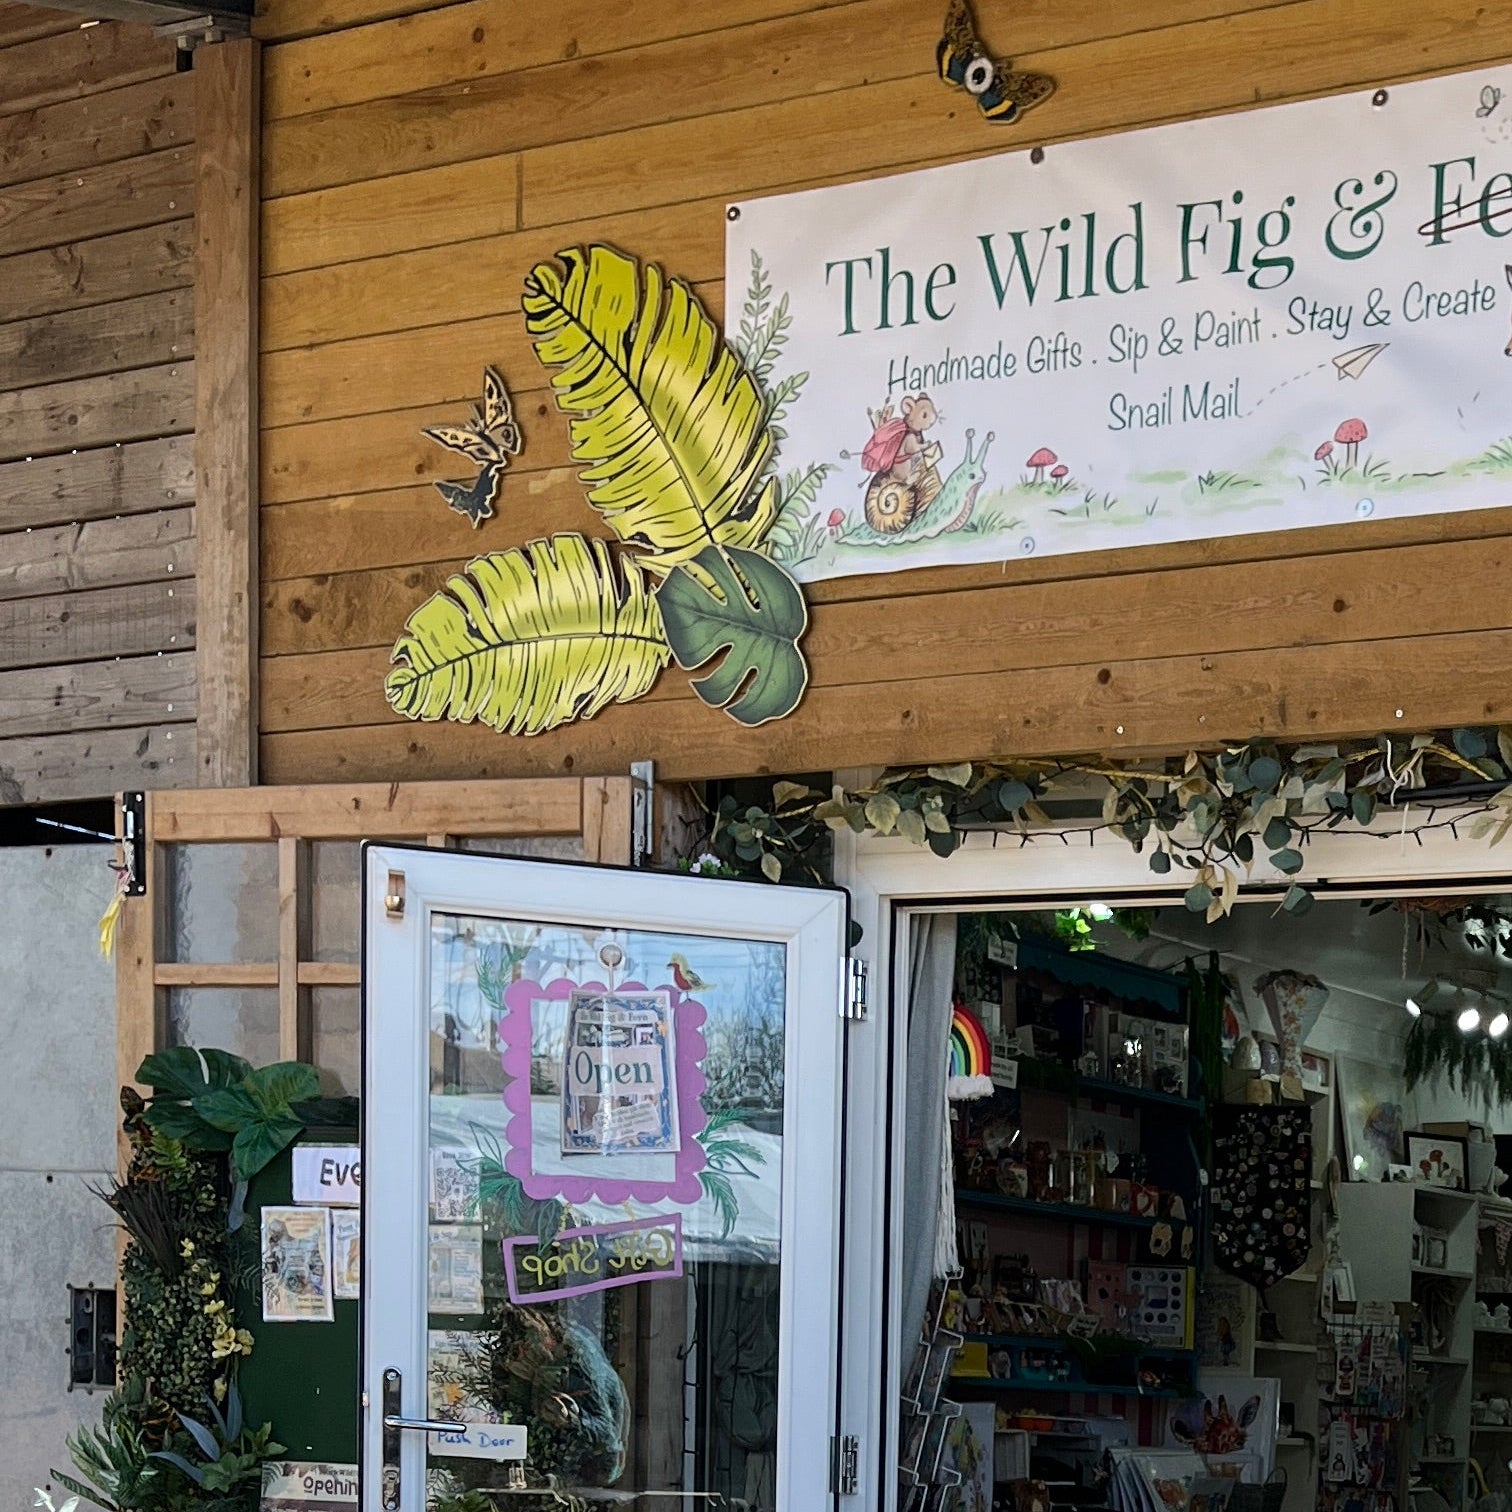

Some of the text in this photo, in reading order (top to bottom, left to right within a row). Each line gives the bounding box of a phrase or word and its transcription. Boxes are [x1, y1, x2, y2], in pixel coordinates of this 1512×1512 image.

[825, 246, 957, 337] The
[977, 202, 1149, 310] Wild
[1176, 190, 1296, 290] Fig
[1324, 169, 1398, 260] &
[888, 340, 1017, 394] Handmade
[1027, 331, 1082, 375] Gifts
[1108, 323, 1148, 374] Sip
[1158, 316, 1183, 357] &
[1194, 308, 1261, 351] Paint
[1287, 296, 1353, 341] Stay
[1363, 288, 1391, 327] &
[1403, 279, 1496, 323] Create
[1108, 377, 1242, 431] Snail Mail
[575, 1050, 656, 1094] Open
